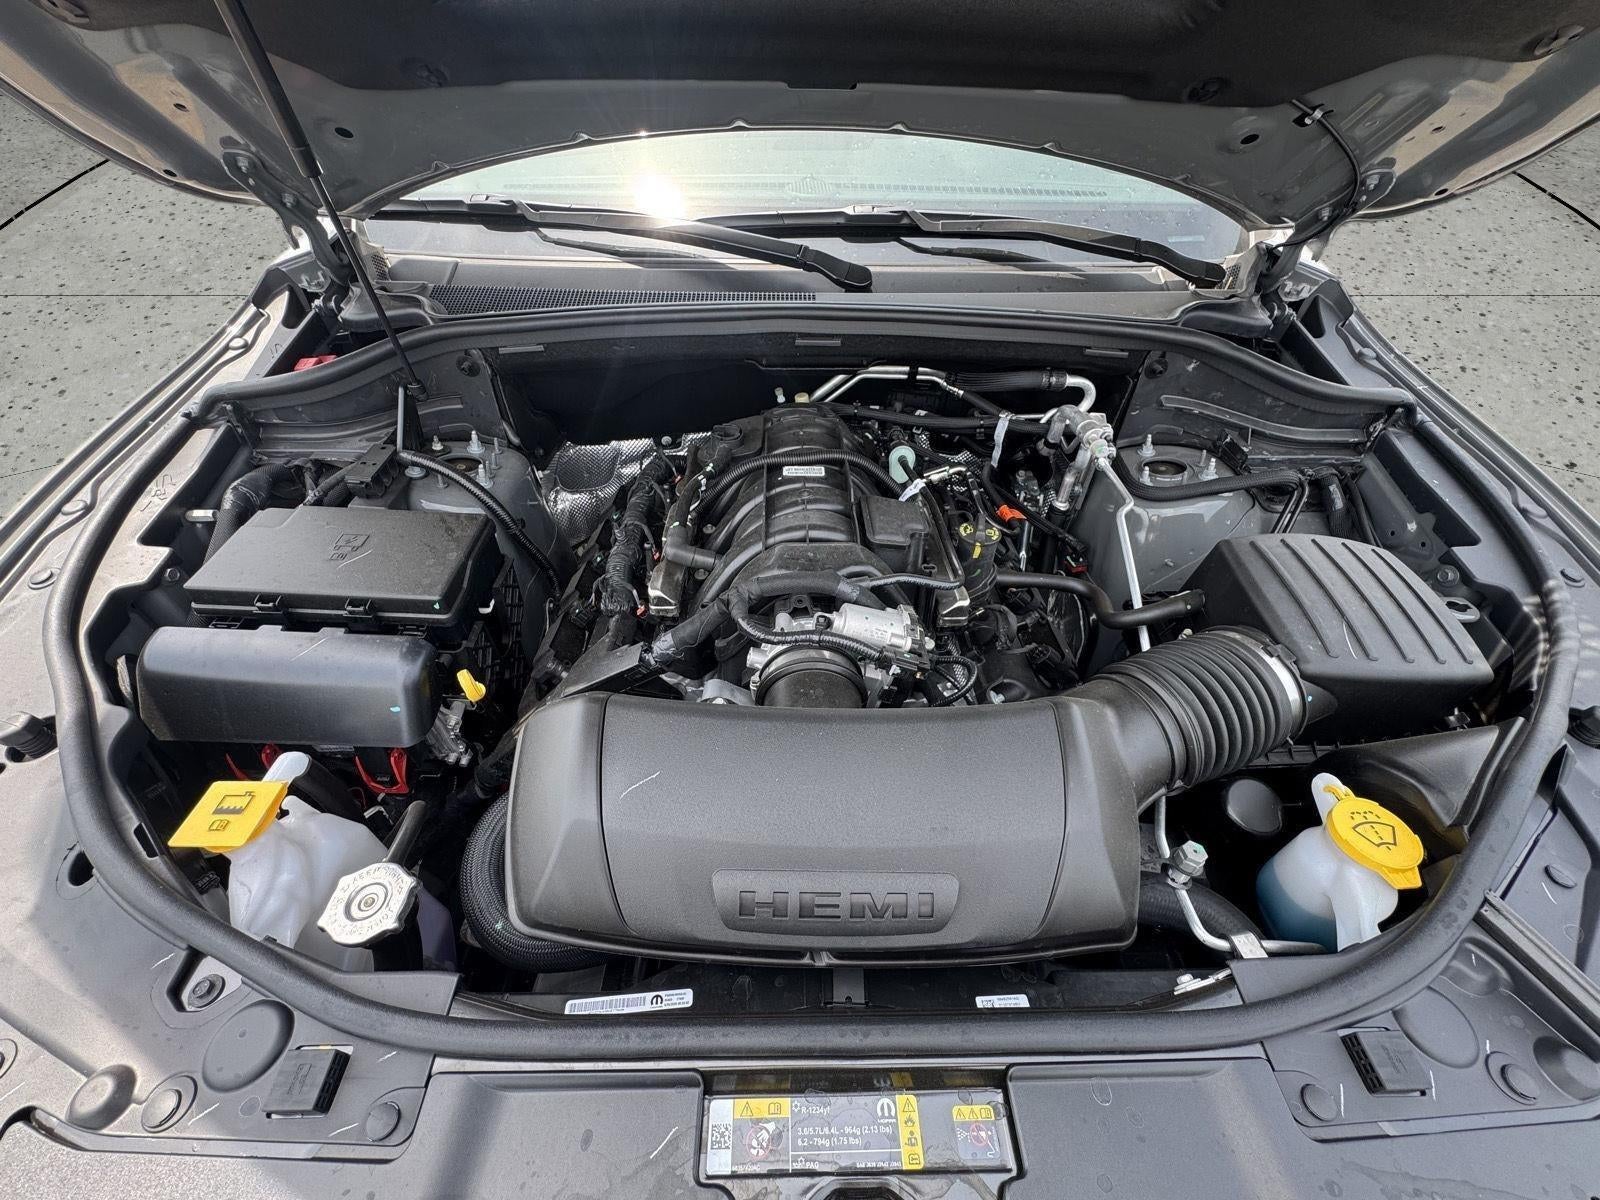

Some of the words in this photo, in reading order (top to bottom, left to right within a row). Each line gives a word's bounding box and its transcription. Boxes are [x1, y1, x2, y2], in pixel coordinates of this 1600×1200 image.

[738, 890, 935, 919] HEMI
[879, 1125, 892, 1135] lbs)
[848, 1136, 862, 1146] lbs)
